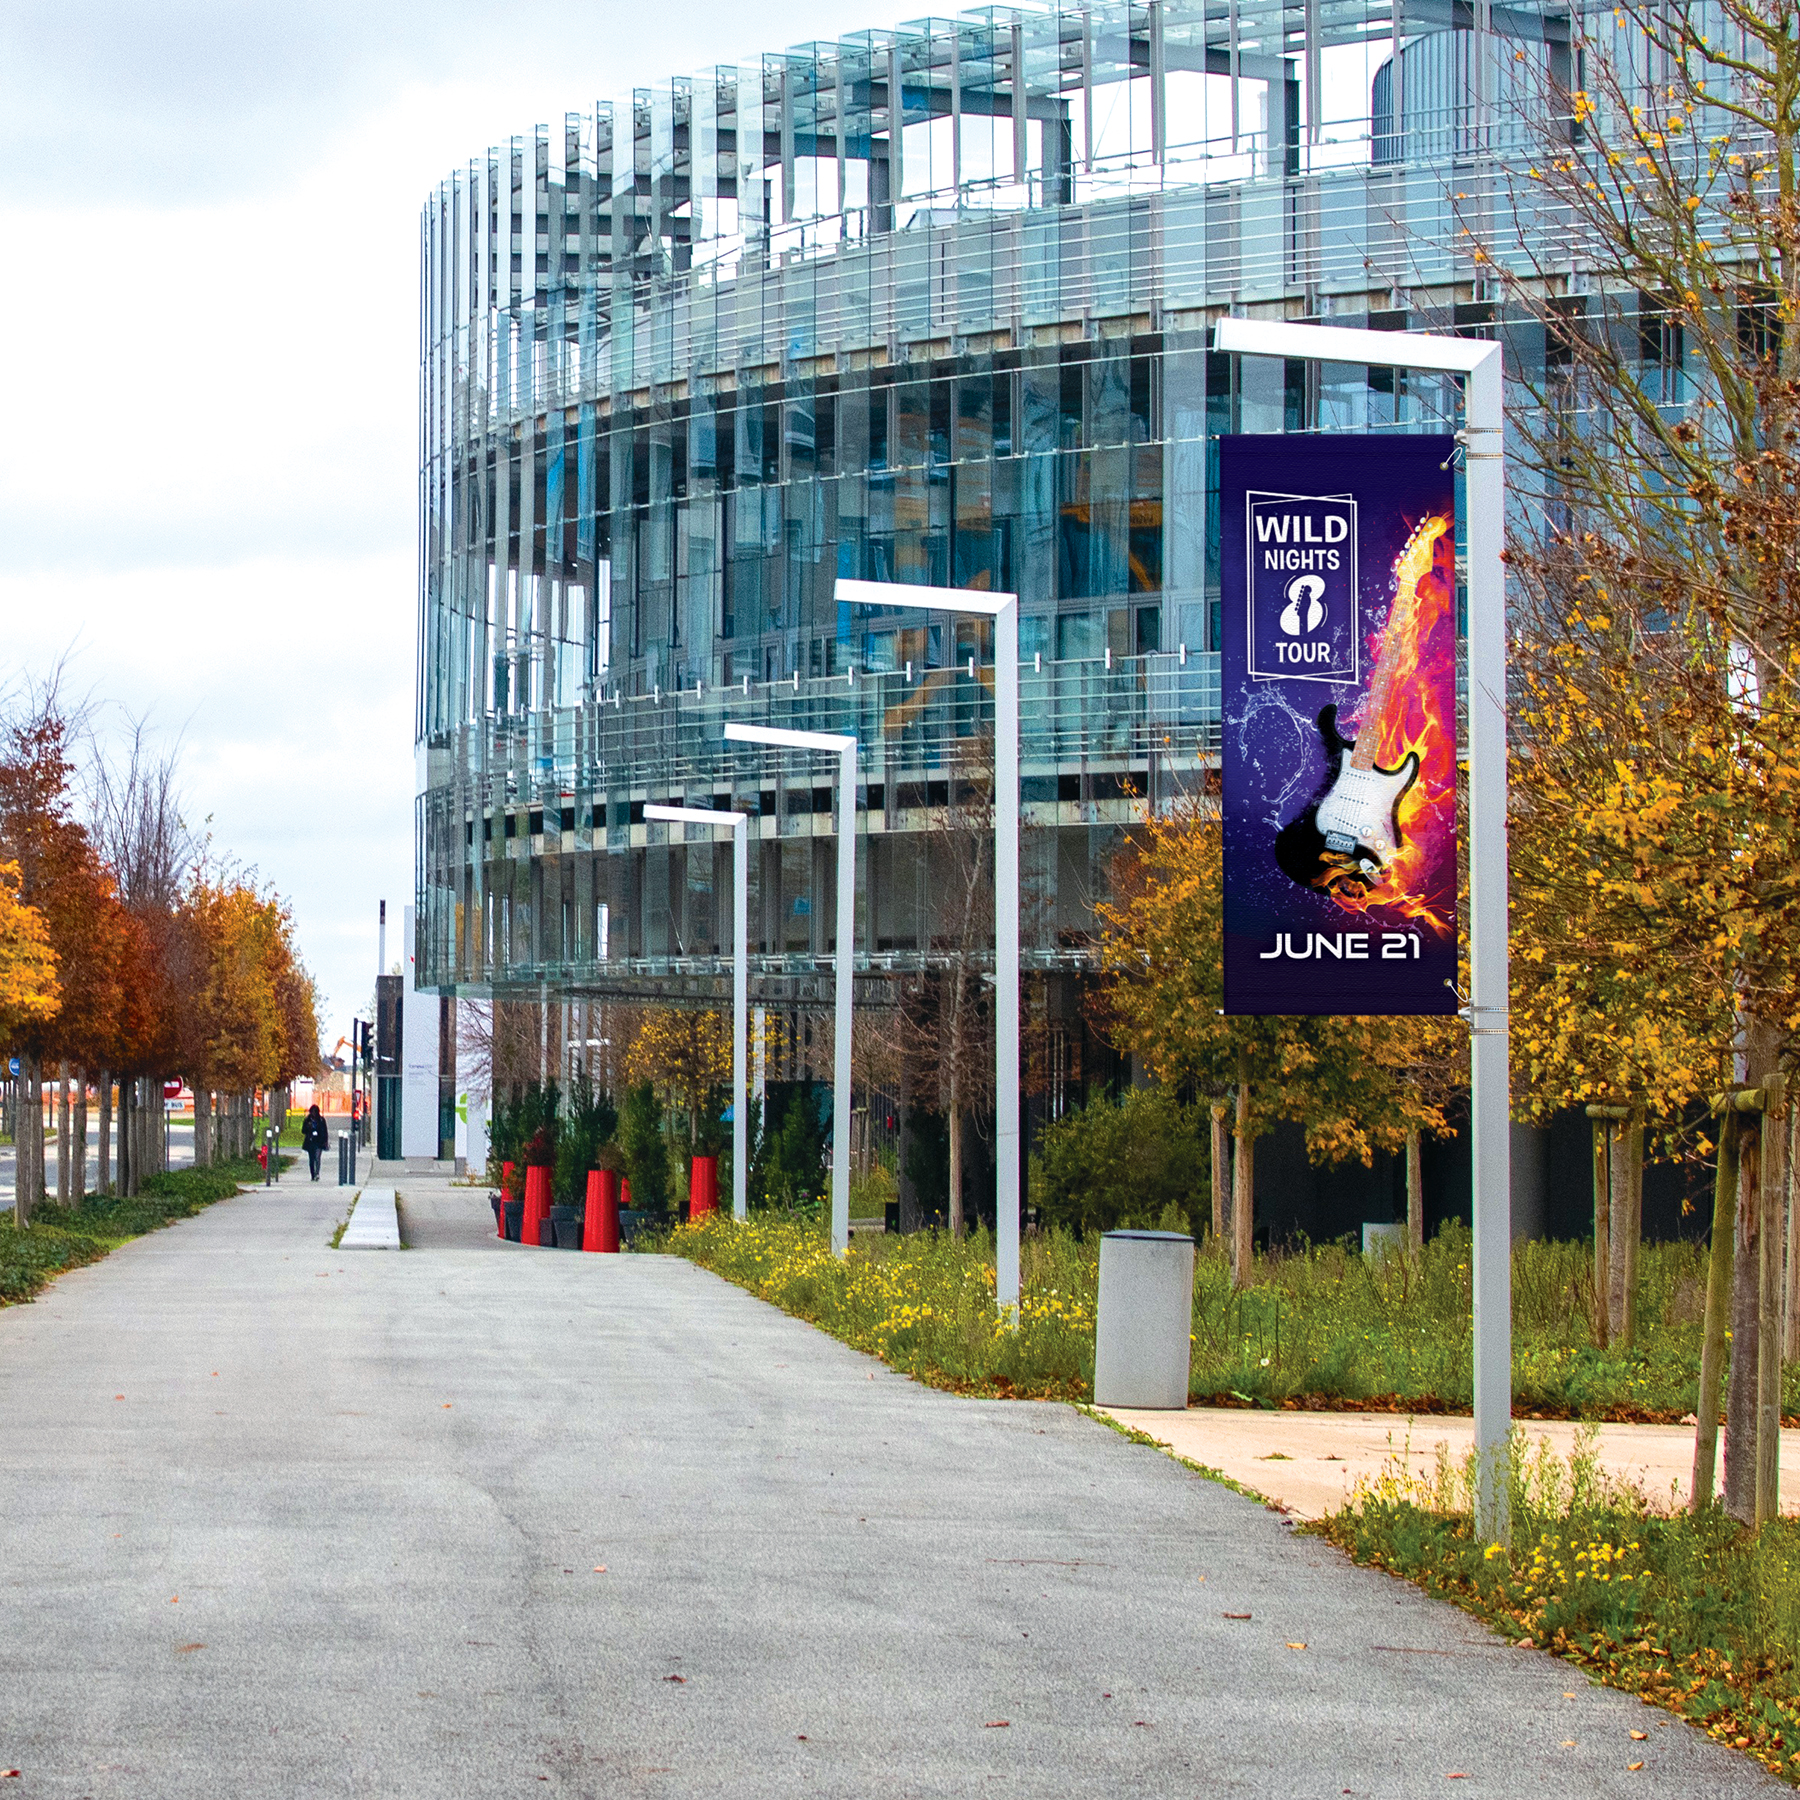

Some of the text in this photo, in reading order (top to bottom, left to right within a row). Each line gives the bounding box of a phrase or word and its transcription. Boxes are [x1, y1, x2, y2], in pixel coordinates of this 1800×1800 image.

[1255, 515, 1348, 543] WILD
[1264, 549, 1340, 570] NIGHTS
[1275, 642, 1331, 663] TOUR
[1259, 933, 1420, 959] JUNE 21
